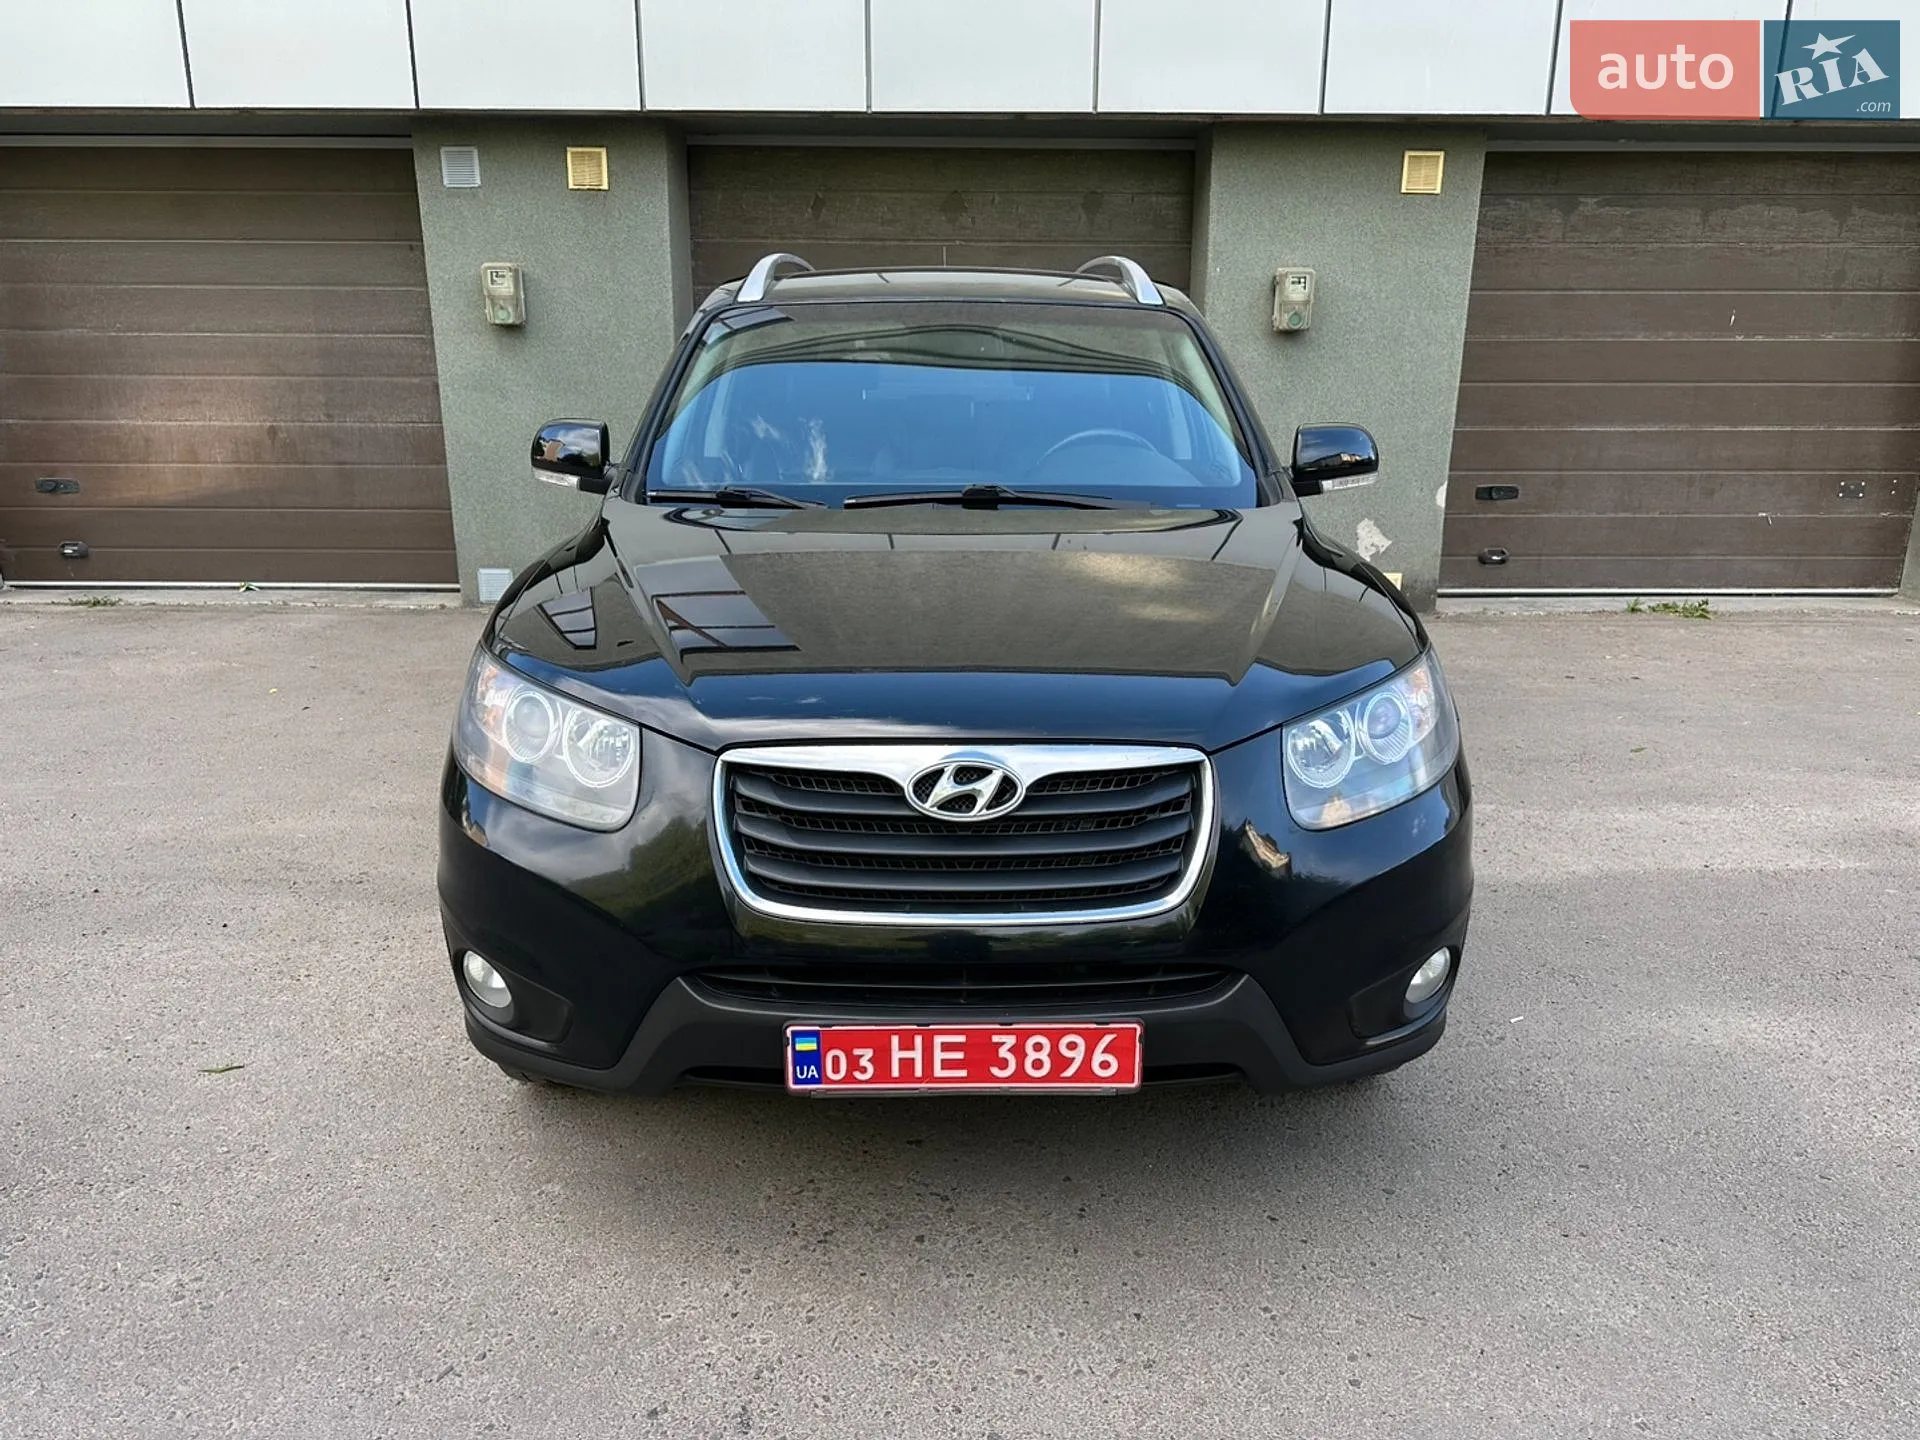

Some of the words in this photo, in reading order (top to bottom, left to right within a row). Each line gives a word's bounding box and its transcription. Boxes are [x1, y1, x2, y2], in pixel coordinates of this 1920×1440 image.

[796, 1065, 819, 1079] UA
[825, 1048, 874, 1081] 03
[890, 1034, 968, 1079] HE
[989, 1034, 1119, 1079] 3896
